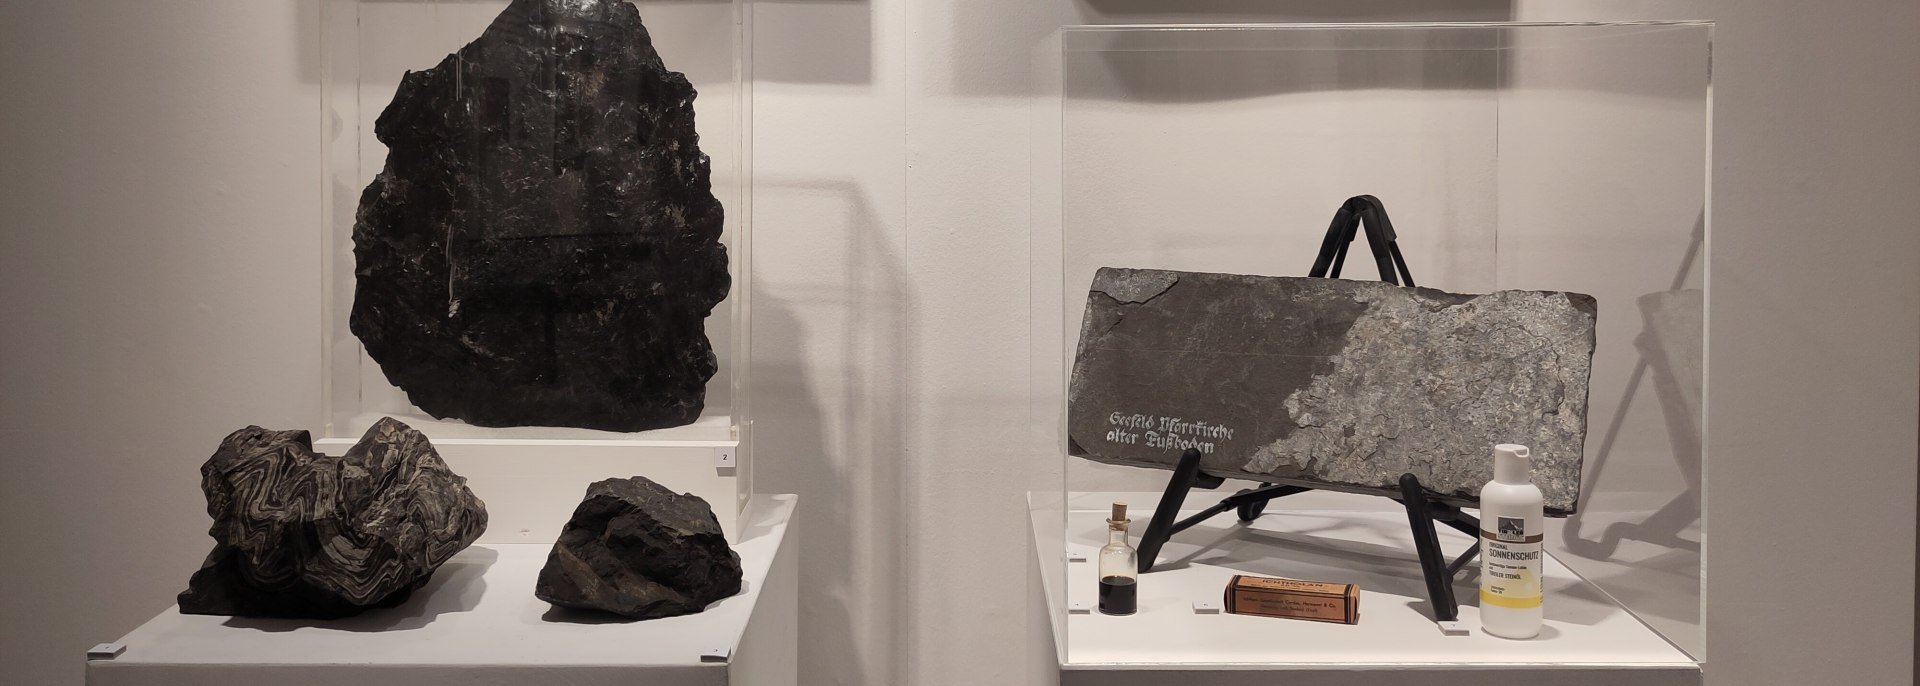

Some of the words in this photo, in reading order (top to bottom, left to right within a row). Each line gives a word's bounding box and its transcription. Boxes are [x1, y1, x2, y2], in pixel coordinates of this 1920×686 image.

[1109, 411, 1155, 431] Seefeld
[1158, 416, 1234, 442] Pfarrkirche
[1106, 427, 1139, 445] alter
[722, 453, 728, 461] 2
[1489, 548, 1539, 561] SONNENSCHUTZ
